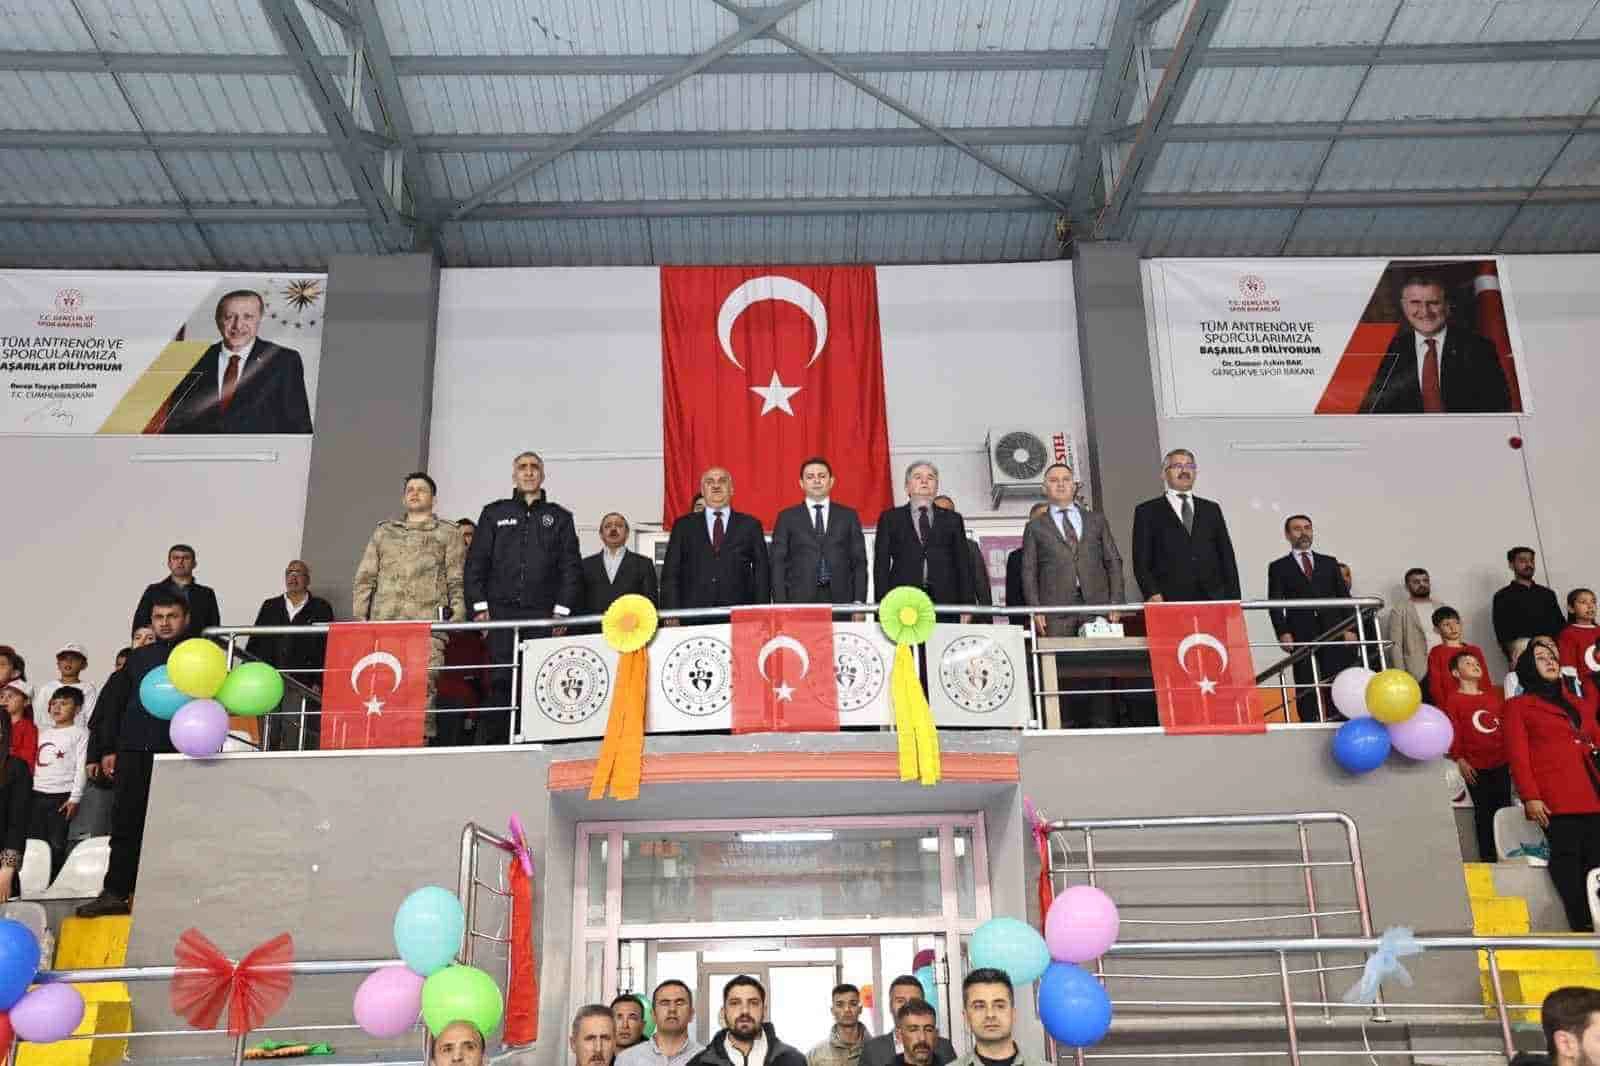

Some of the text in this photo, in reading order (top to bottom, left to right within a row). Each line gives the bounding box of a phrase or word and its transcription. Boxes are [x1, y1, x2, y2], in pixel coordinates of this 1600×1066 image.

[1200, 320, 1315, 332] TÜM ANTRENÖR VE
[1, 336, 124, 349] TÜM ANTRENÖR VE
[1204, 333, 1312, 343] SPORCULARIMIZA
[2, 349, 118, 360] SPORCULARIMIZA
[1199, 344, 1321, 355] BAŞARILAR DİLİYORUM
[0, 361, 123, 372] AŞARILAR DİLİYORUM
